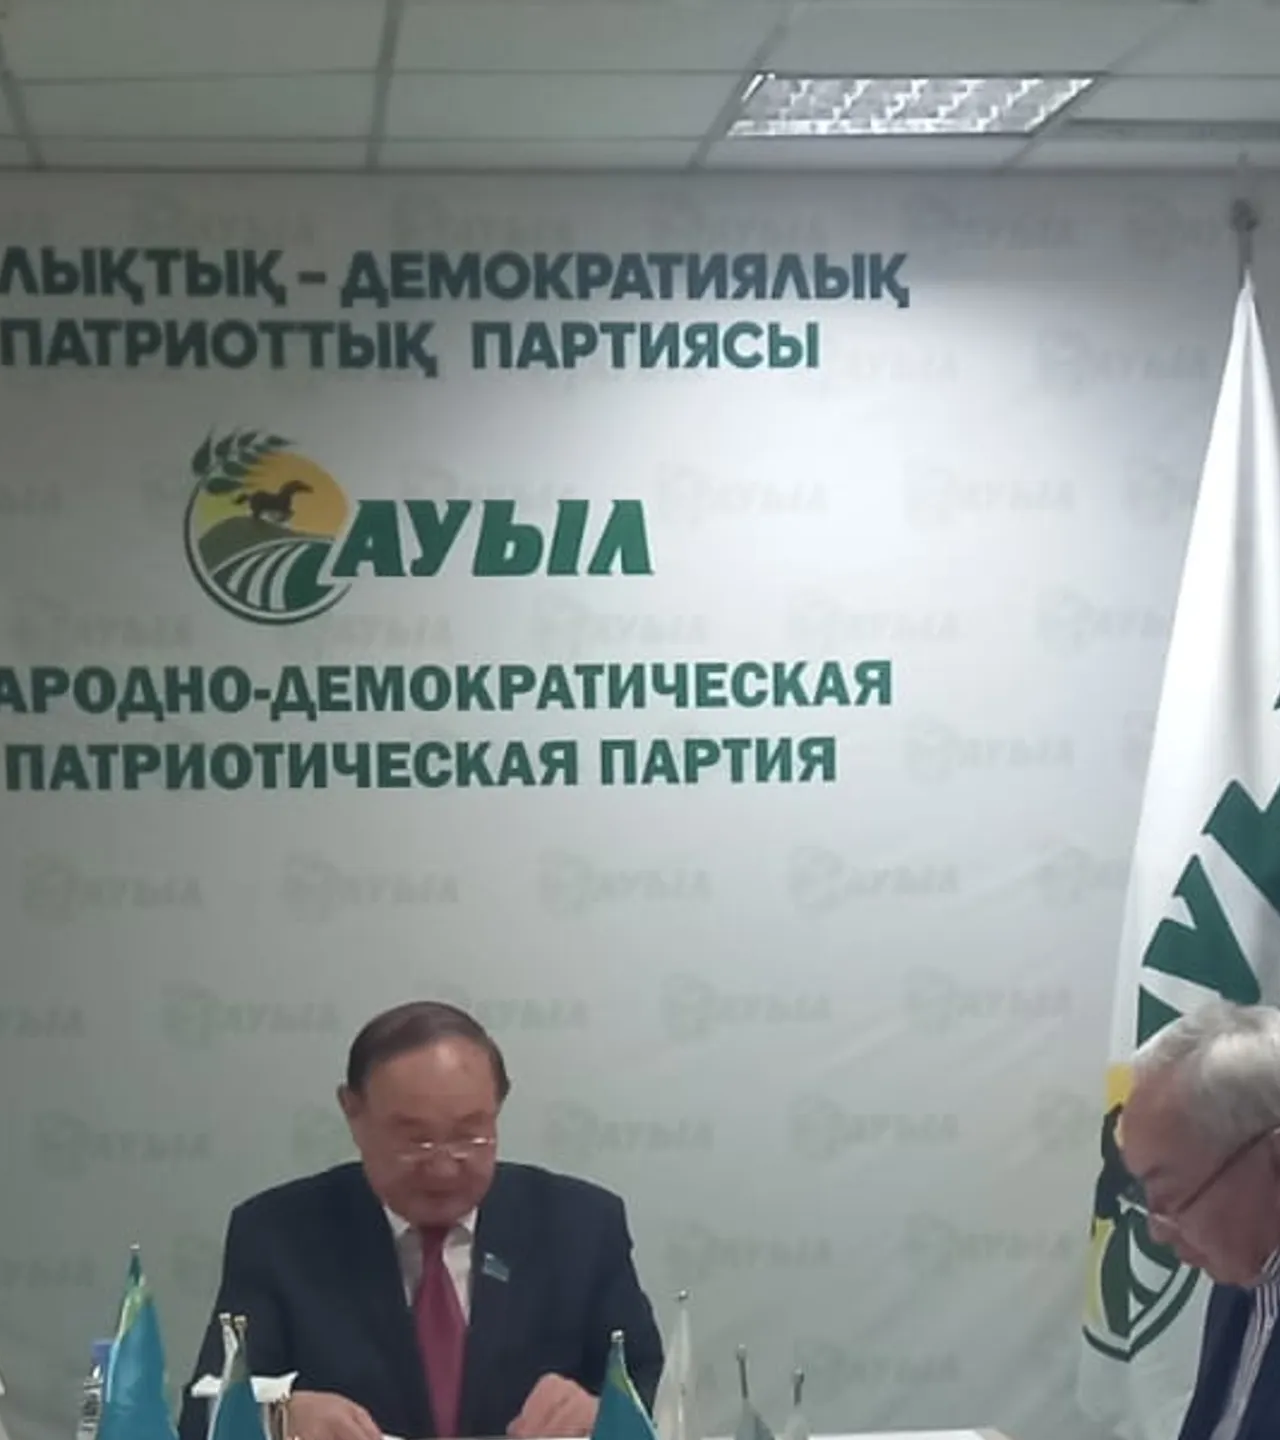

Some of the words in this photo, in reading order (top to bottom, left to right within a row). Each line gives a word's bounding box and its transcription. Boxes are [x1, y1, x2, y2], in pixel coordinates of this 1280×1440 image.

[340, 250, 911, 309] ДЕМОКРАТИЯЛЫҚ
[0, 319, 438, 379] ПАТРИОТТЫҚ
[471, 320, 820, 371] ПАРТИЯСЫ
[330, 498, 655, 578] АУЫЛ
[5, 739, 580, 791] ПАТРИОТИЧЕСКАЯ
[599, 735, 838, 786] ПАРТИЯ
